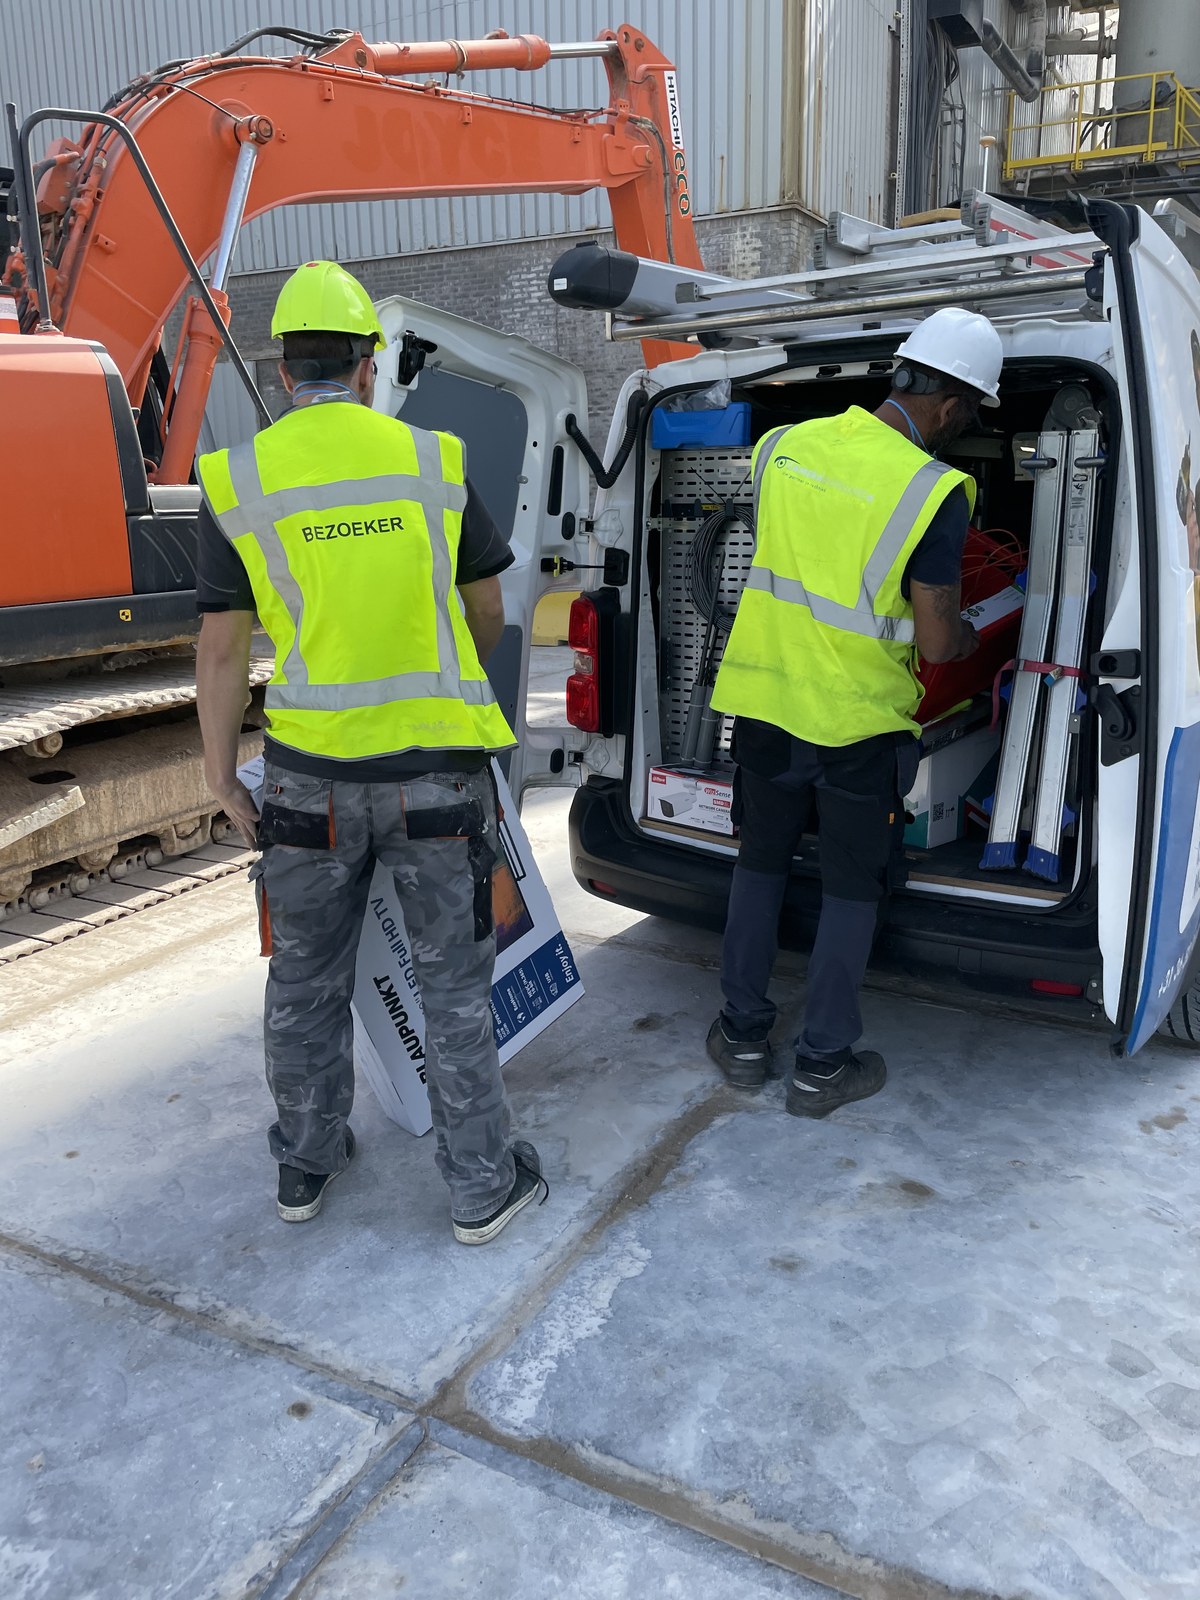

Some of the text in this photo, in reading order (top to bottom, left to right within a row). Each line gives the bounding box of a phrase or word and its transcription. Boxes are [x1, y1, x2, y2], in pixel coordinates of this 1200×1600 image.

[667, 76, 680, 145] HITACHI
[301, 517, 404, 542] BEZOEKER
[370, 898, 388, 920] TV
[381, 917, 399, 942] HD
[390, 939, 411, 968] Full
[555, 943, 574, 983] Enjoy it.
[544, 972, 552, 983] USB
